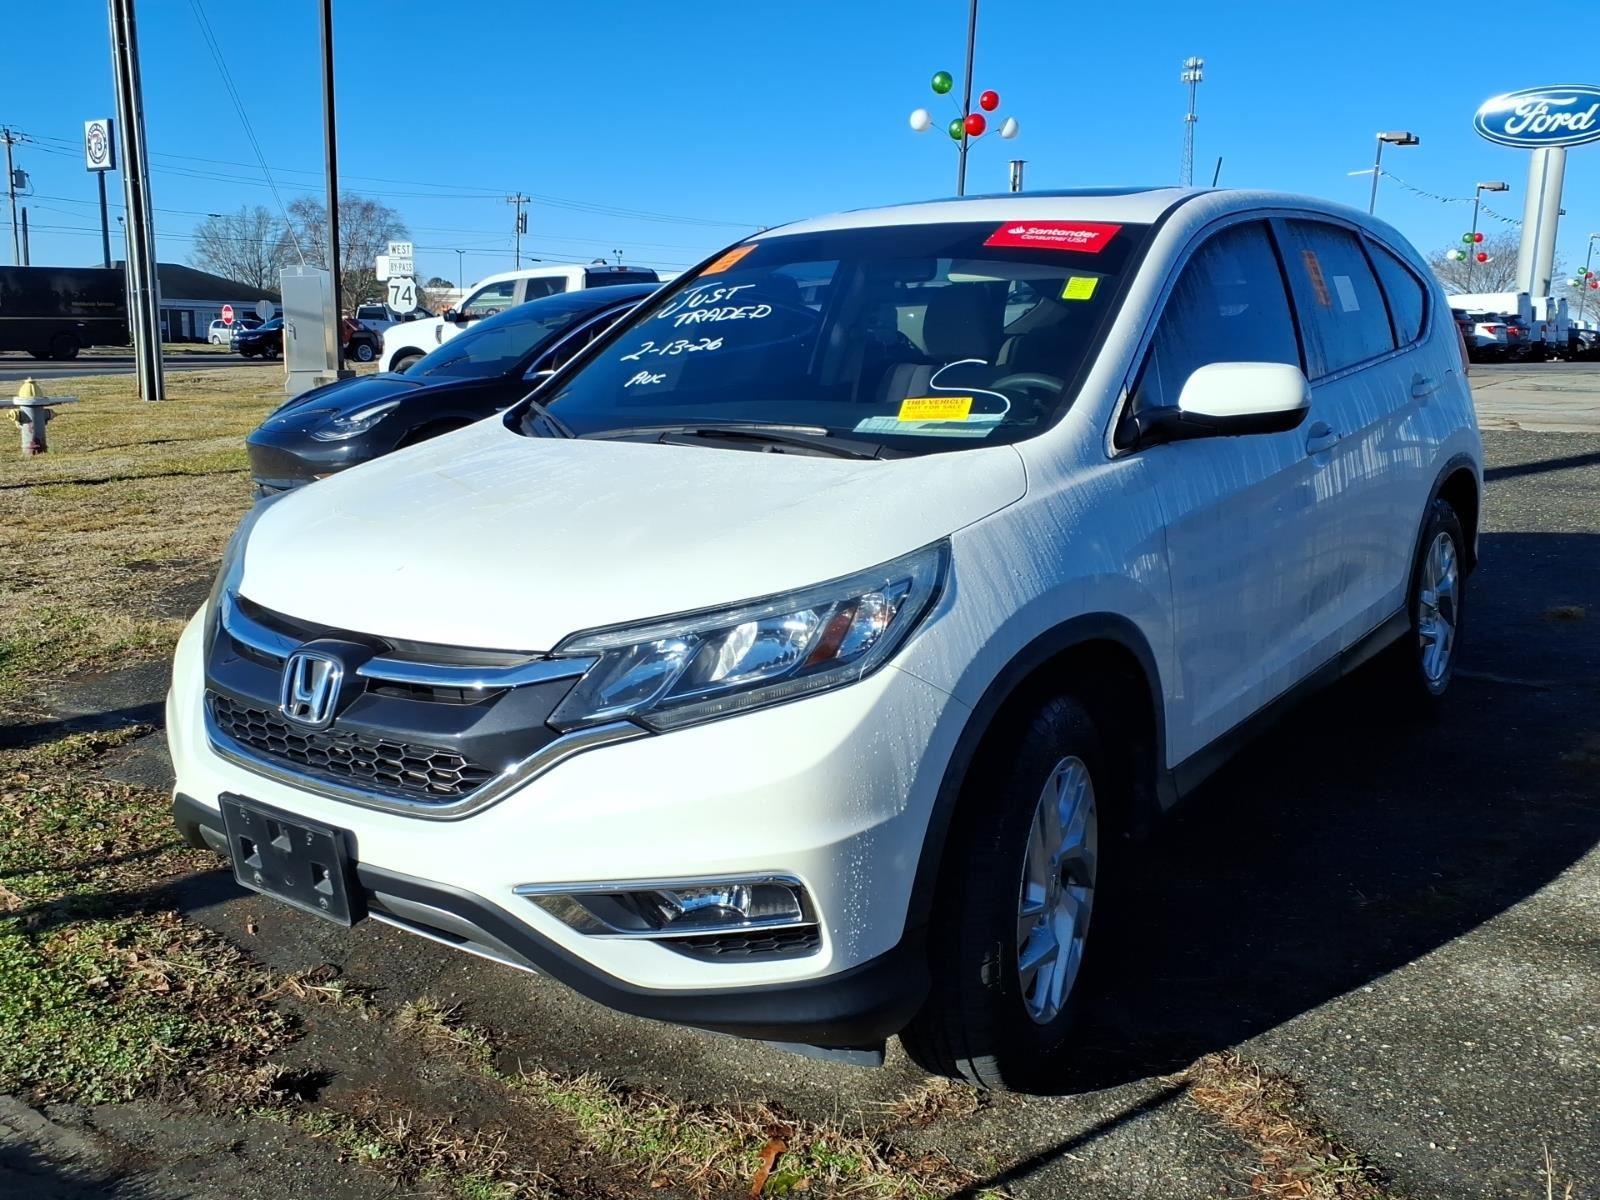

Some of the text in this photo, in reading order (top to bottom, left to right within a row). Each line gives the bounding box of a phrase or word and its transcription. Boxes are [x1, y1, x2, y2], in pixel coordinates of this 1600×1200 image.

[1505, 97, 1600, 134] Ford
[1021, 234, 1088, 244] Consumer USA
[1026, 227, 1100, 238] Santander
[391, 244, 410, 254] WEST
[390, 285, 413, 305] 74
[658, 282, 755, 319] JUST
[674, 304, 772, 328] TRADED
[620, 337, 724, 361] 2-13-26
[928, 398, 966, 406] VEHICLE
